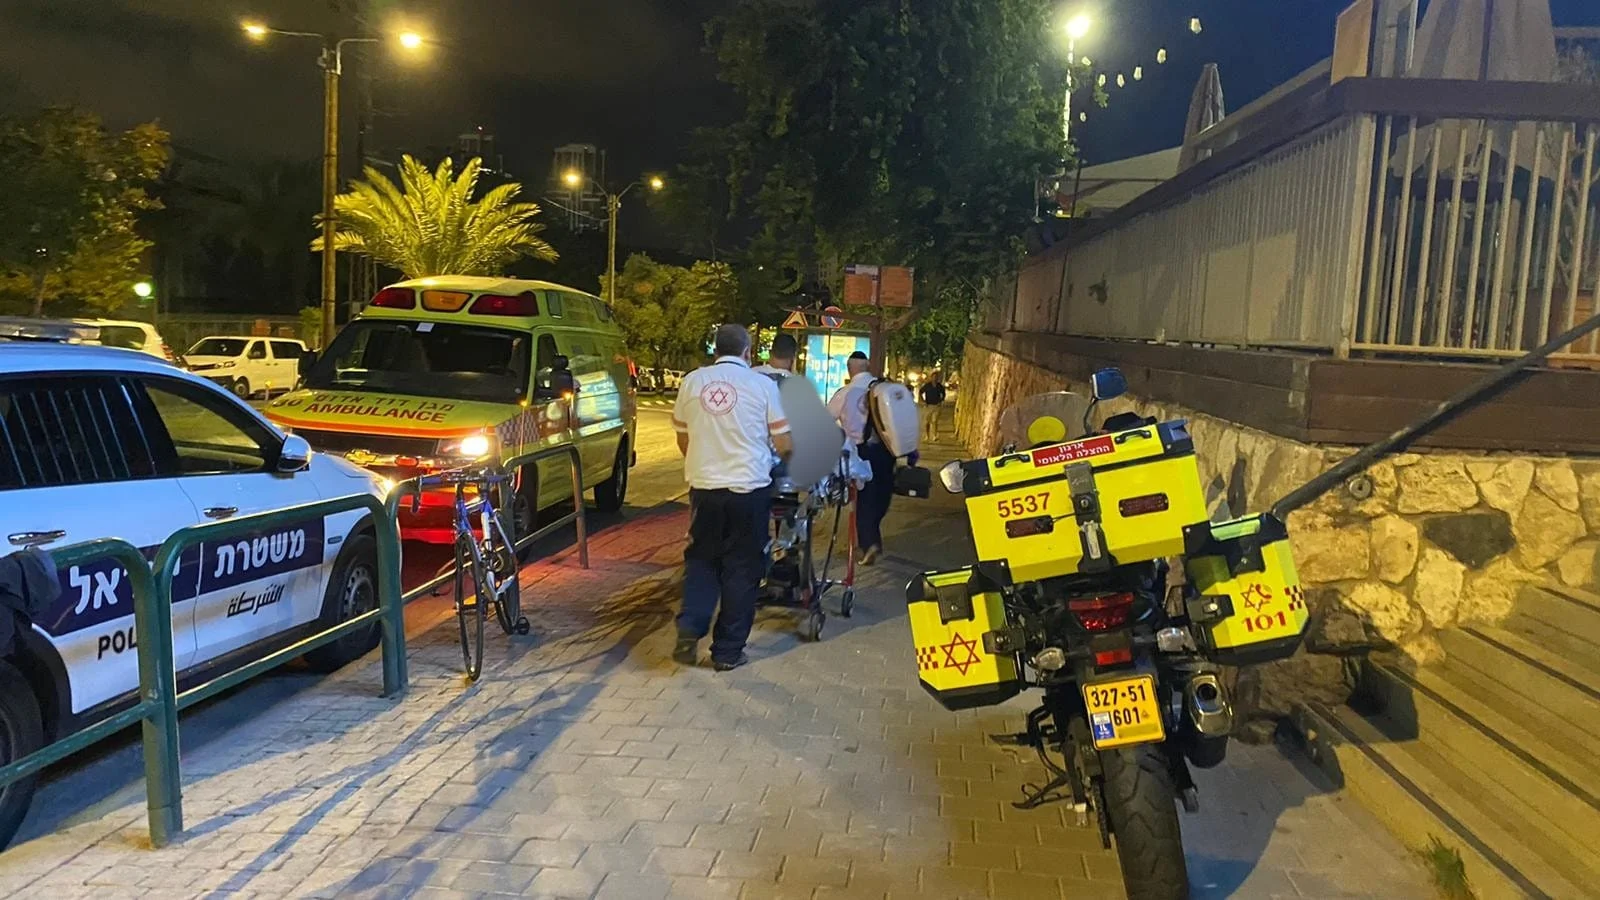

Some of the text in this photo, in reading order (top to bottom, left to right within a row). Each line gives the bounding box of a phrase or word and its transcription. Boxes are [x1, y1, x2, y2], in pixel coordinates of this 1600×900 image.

[304, 403, 448, 423] AMBULANCE
[315, 394, 455, 411] מגן דוד אדום
[1038, 444, 1110, 465] ההצלה הלאומי
[1058, 441, 1085, 453] ארגון
[998, 492, 1050, 518] 5537
[214, 528, 305, 578] משטרת
[227, 584, 286, 618] الشرطة
[1241, 611, 1287, 633] 101
[1113, 706, 1141, 727] 601
